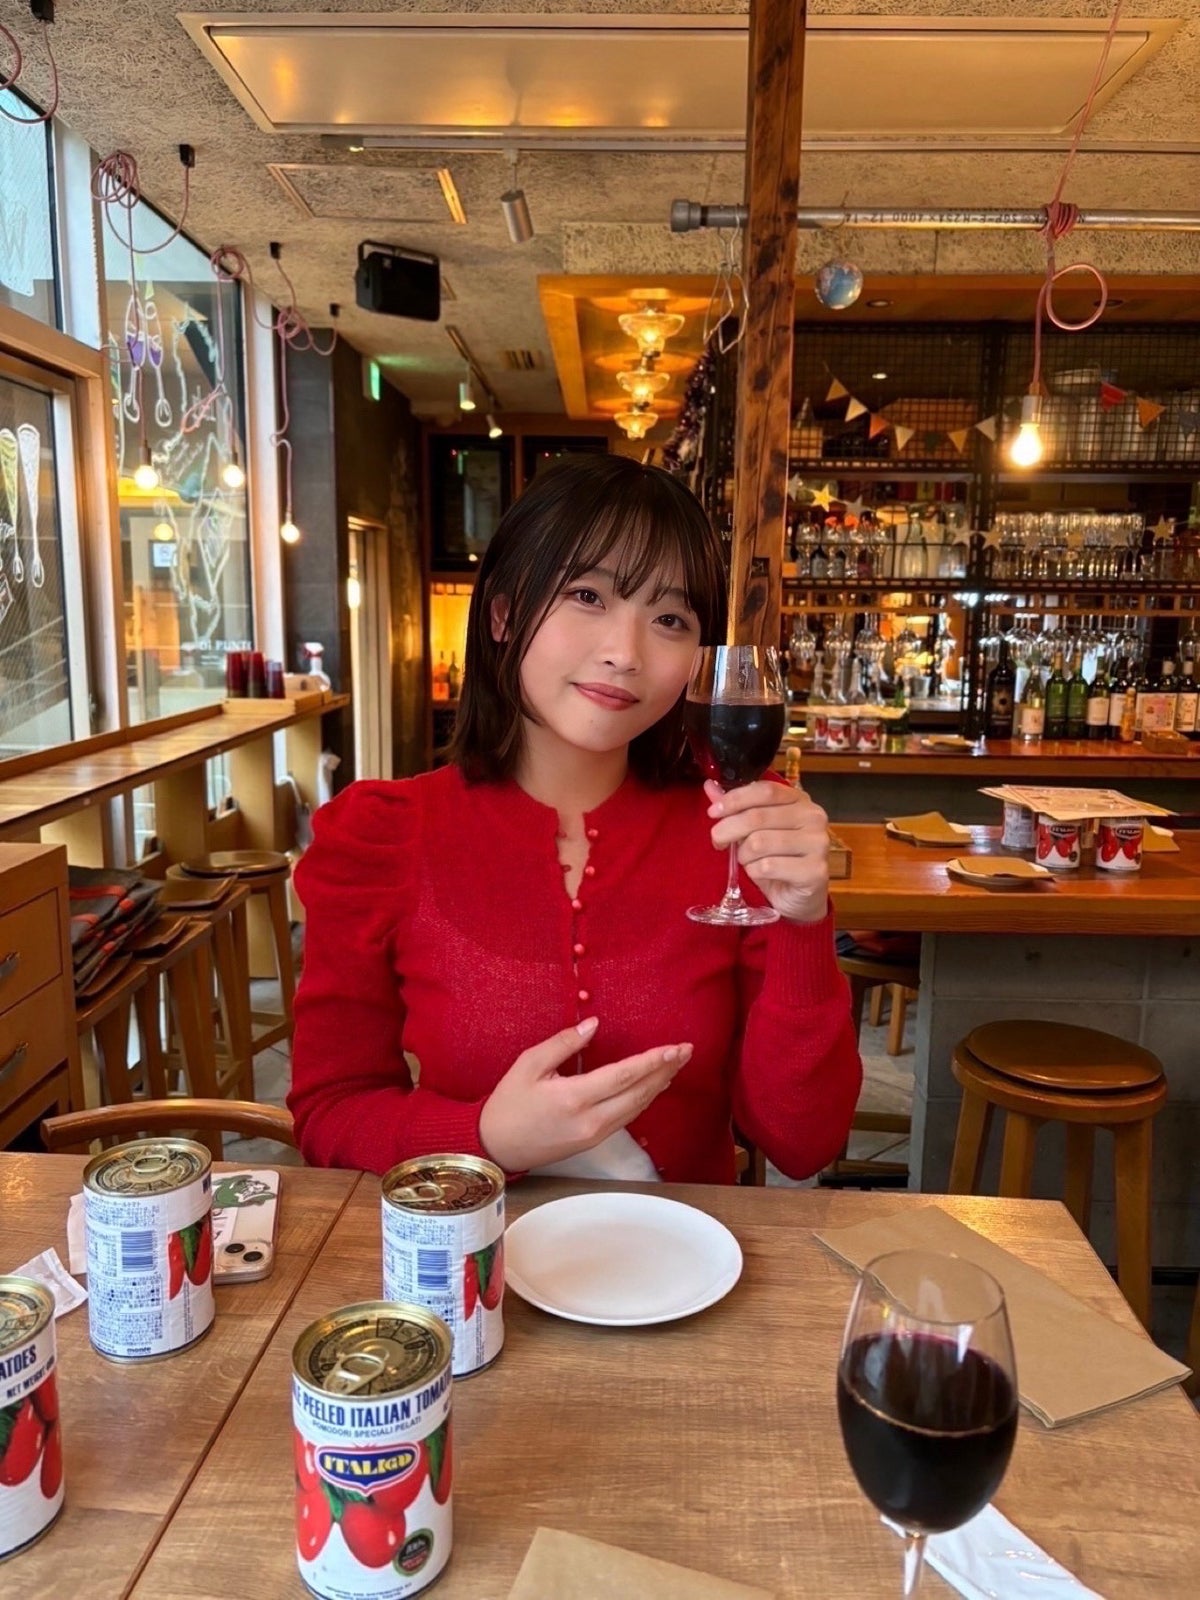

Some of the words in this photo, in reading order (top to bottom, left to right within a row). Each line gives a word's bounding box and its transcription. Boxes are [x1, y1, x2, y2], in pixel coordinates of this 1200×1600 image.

[303, 1392, 345, 1426] PEELED
[351, 1399, 411, 1428] ITALIAN
[312, 1419, 351, 1438] POMODORI
[354, 1425, 393, 1438] SPECIALI
[395, 1415, 421, 1432] PELATI
